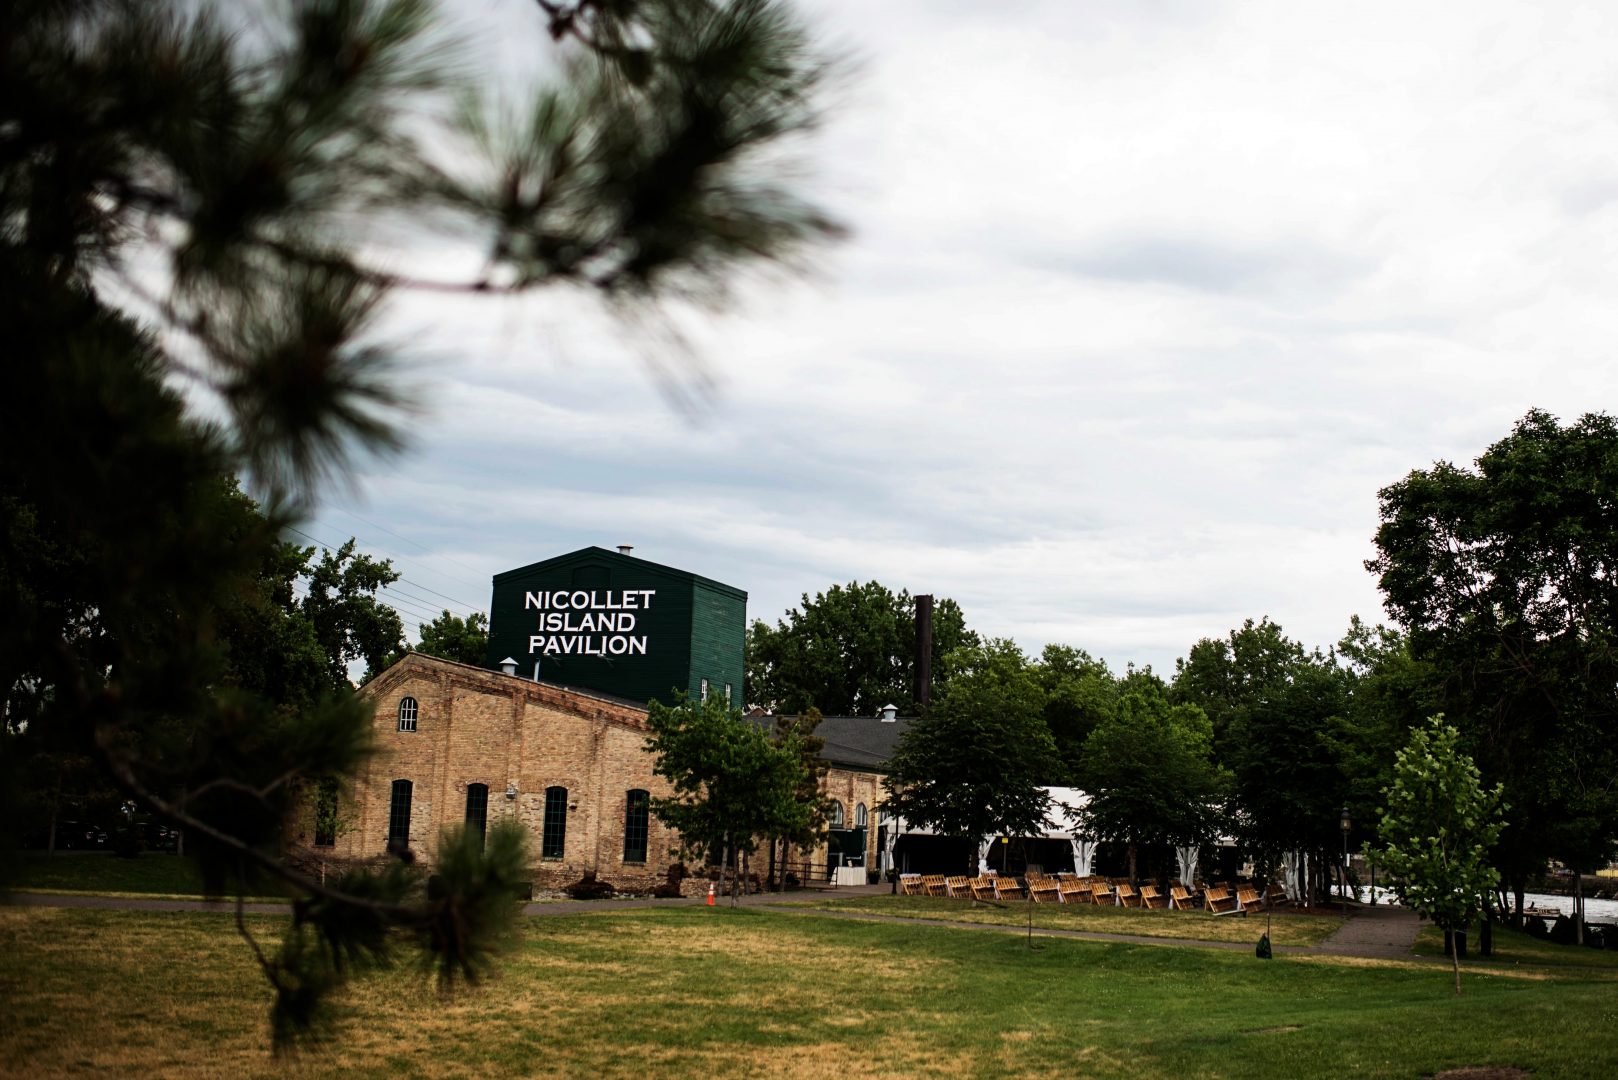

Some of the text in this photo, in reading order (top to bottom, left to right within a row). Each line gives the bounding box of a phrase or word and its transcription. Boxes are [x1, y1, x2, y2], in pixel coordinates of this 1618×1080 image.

[525, 590, 656, 610] NICOLLET
[538, 612, 636, 632] ISLAND
[528, 635, 648, 655] PAVILION
